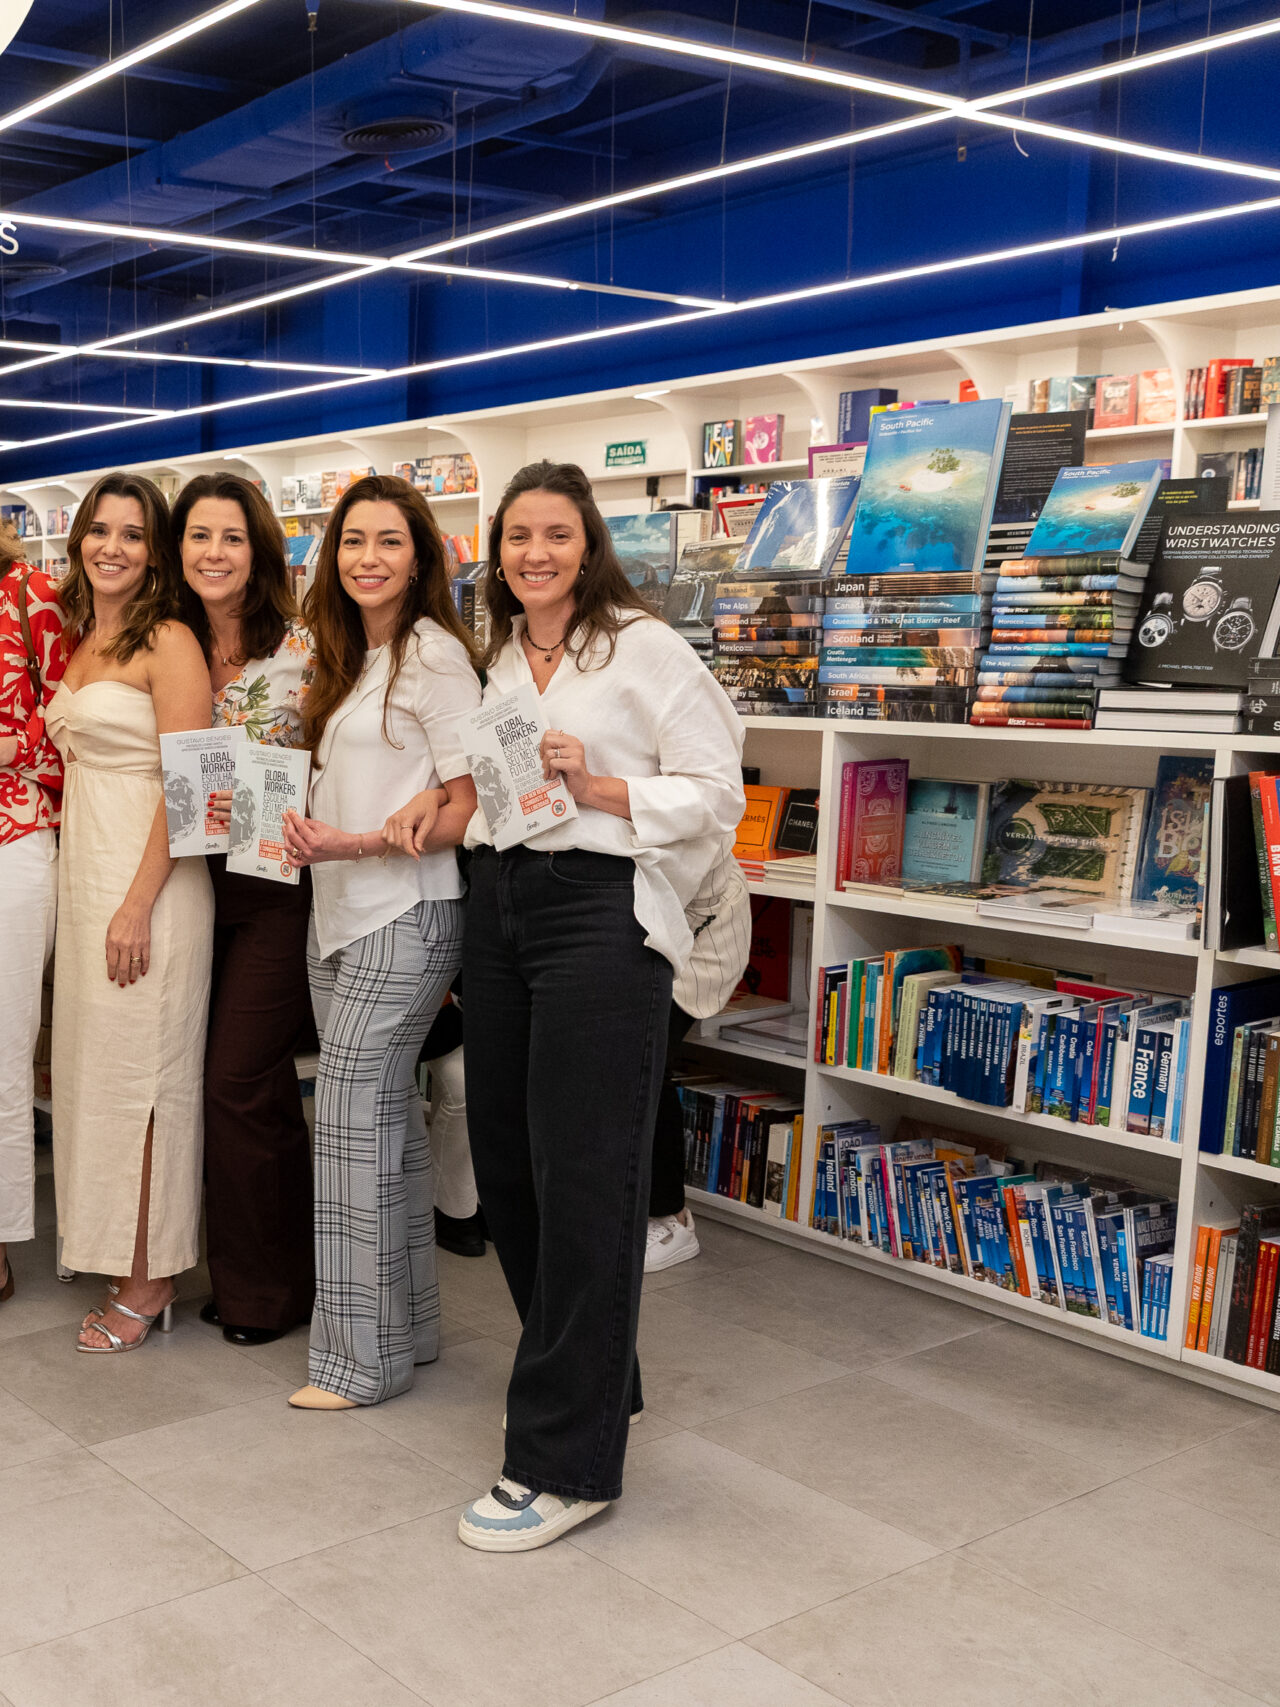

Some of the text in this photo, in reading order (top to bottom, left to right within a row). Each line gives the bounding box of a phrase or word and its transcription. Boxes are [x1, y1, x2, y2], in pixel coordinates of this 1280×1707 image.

[880, 418, 934, 431] South Pacific
[609, 445, 642, 457] SAÍDA
[1168, 524, 1280, 535] UNDERSTANDING
[1166, 537, 1276, 548] WRISTWATCHES
[835, 582, 865, 593] Japan
[733, 602, 748, 610] Alps
[719, 644, 744, 652] Mexico
[833, 635, 874, 643] Scotland
[828, 688, 853, 696] Israel
[827, 706, 864, 716] Iceland
[495, 714, 526, 737] GLOBAL
[498, 721, 538, 748] WORKERS
[200, 751, 232, 763] GLOBAL
[502, 737, 534, 758] ESCOLHA
[201, 761, 235, 774] WORKER
[506, 754, 520, 768] SEU
[510, 758, 536, 778] FUTURO
[202, 773, 233, 783] ESCOLHA
[265, 769, 289, 783] GLOBAL
[264, 780, 296, 796] WORKERS
[788, 818, 815, 828] CHANEL
[927, 1007, 935, 1031] Austria
[1215, 995, 1228, 1046] esportes
[1068, 1037, 1078, 1059] Croatia
[1056, 1034, 1067, 1087] Caribbean Islands
[1132, 1048, 1154, 1099] France
[1156, 1051, 1172, 1093] Germany
[839, 1136, 862, 1150] JOÃO
[826, 1158, 836, 1193] Ireland
[848, 1166, 857, 1197] London
[867, 1187, 875, 1214] LONDON
[962, 1197, 970, 1215] Paris
[926, 1199, 936, 1238] Netherlands
[940, 1191, 952, 1235] New York City
[1030, 1217, 1038, 1238] Rome
[1059, 1237, 1069, 1268] Francisco
[1081, 1230, 1090, 1258] Scotland
[1070, 1240, 1079, 1271] Francisco
[1112, 1258, 1121, 1282] VENICE
[1121, 1271, 1129, 1293] WALES
[1189, 1264, 1203, 1324] JOGUE PARA VENCER
[1201, 1267, 1214, 1327] JOGUE PARA VENCER
